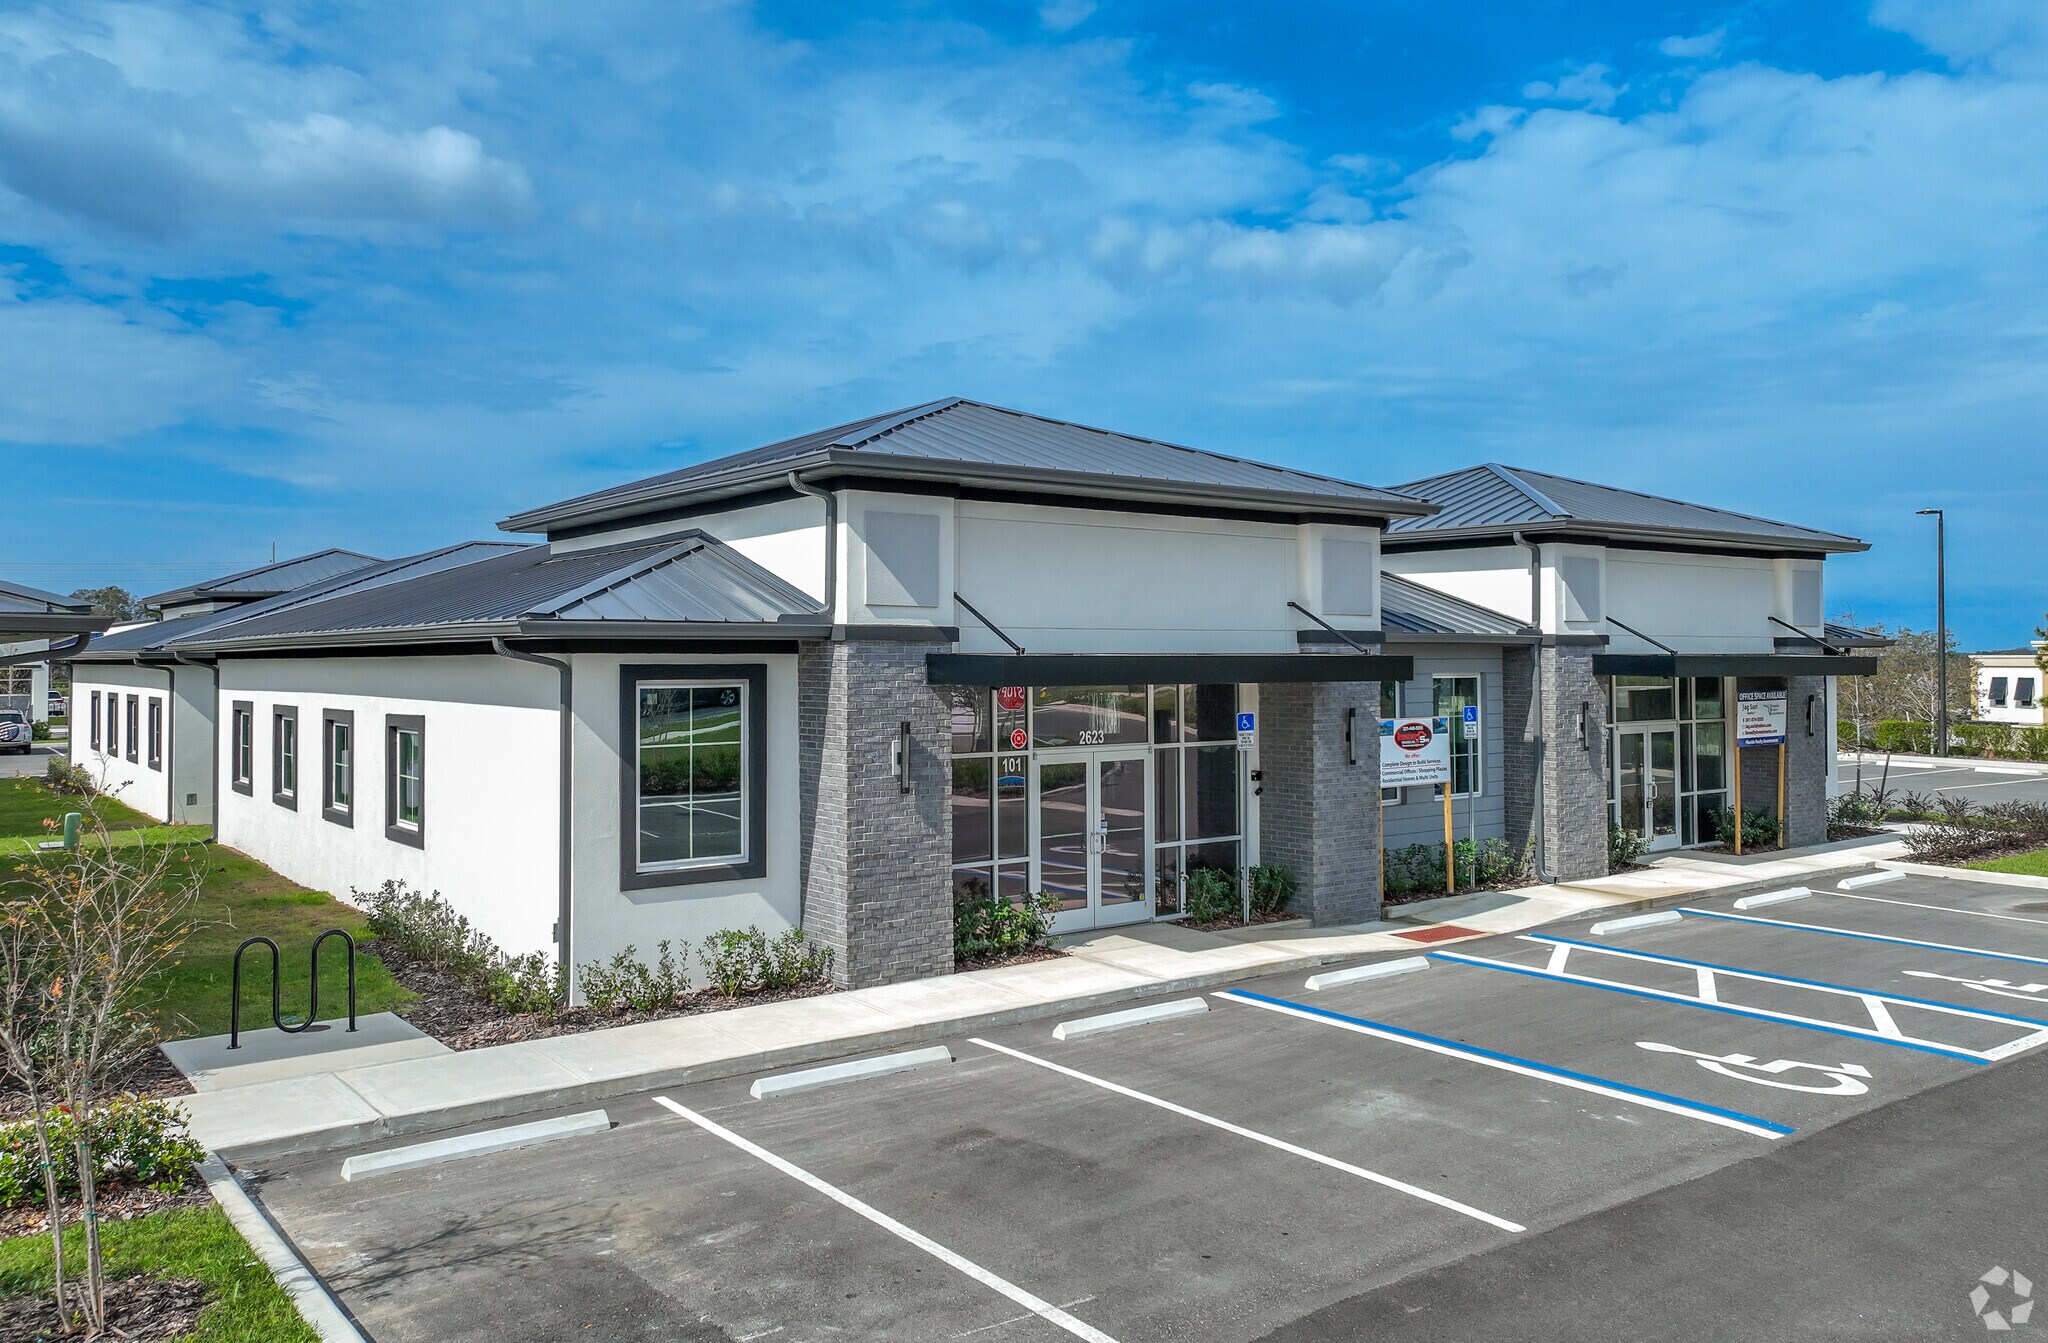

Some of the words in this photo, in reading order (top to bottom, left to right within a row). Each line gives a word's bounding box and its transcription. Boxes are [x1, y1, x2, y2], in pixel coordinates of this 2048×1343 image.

[1766, 691, 1786, 699] AVAILABLE
[1079, 730, 1104, 744] 2623
[1003, 758, 1021, 772] 101
